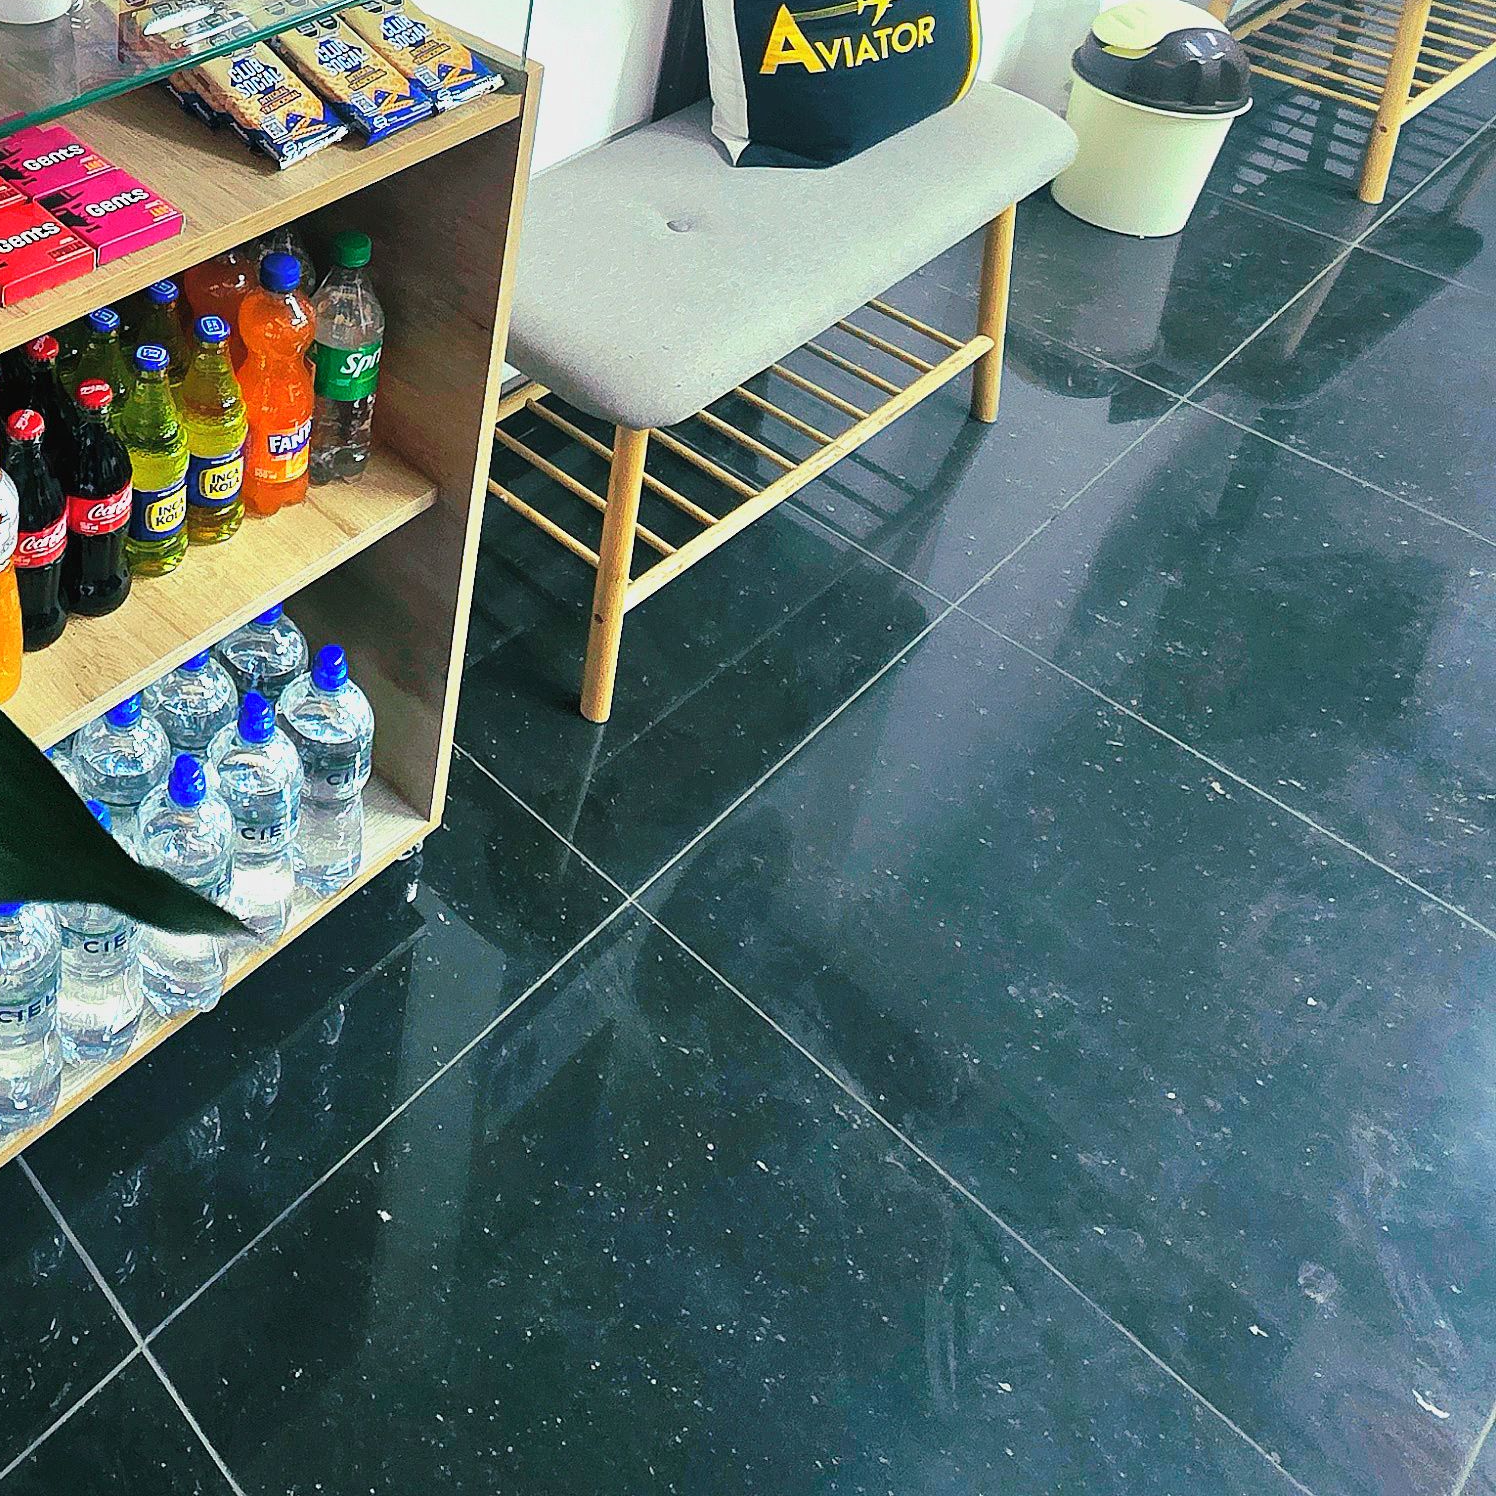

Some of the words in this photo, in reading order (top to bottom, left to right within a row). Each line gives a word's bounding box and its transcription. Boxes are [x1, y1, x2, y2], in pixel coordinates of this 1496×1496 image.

[227, 57, 265, 83] CLUB
[21, 143, 86, 172] Gents
[84, 187, 151, 219] Gents
[211, 467, 239, 484] INCA
[158, 497, 184, 516] INCA
